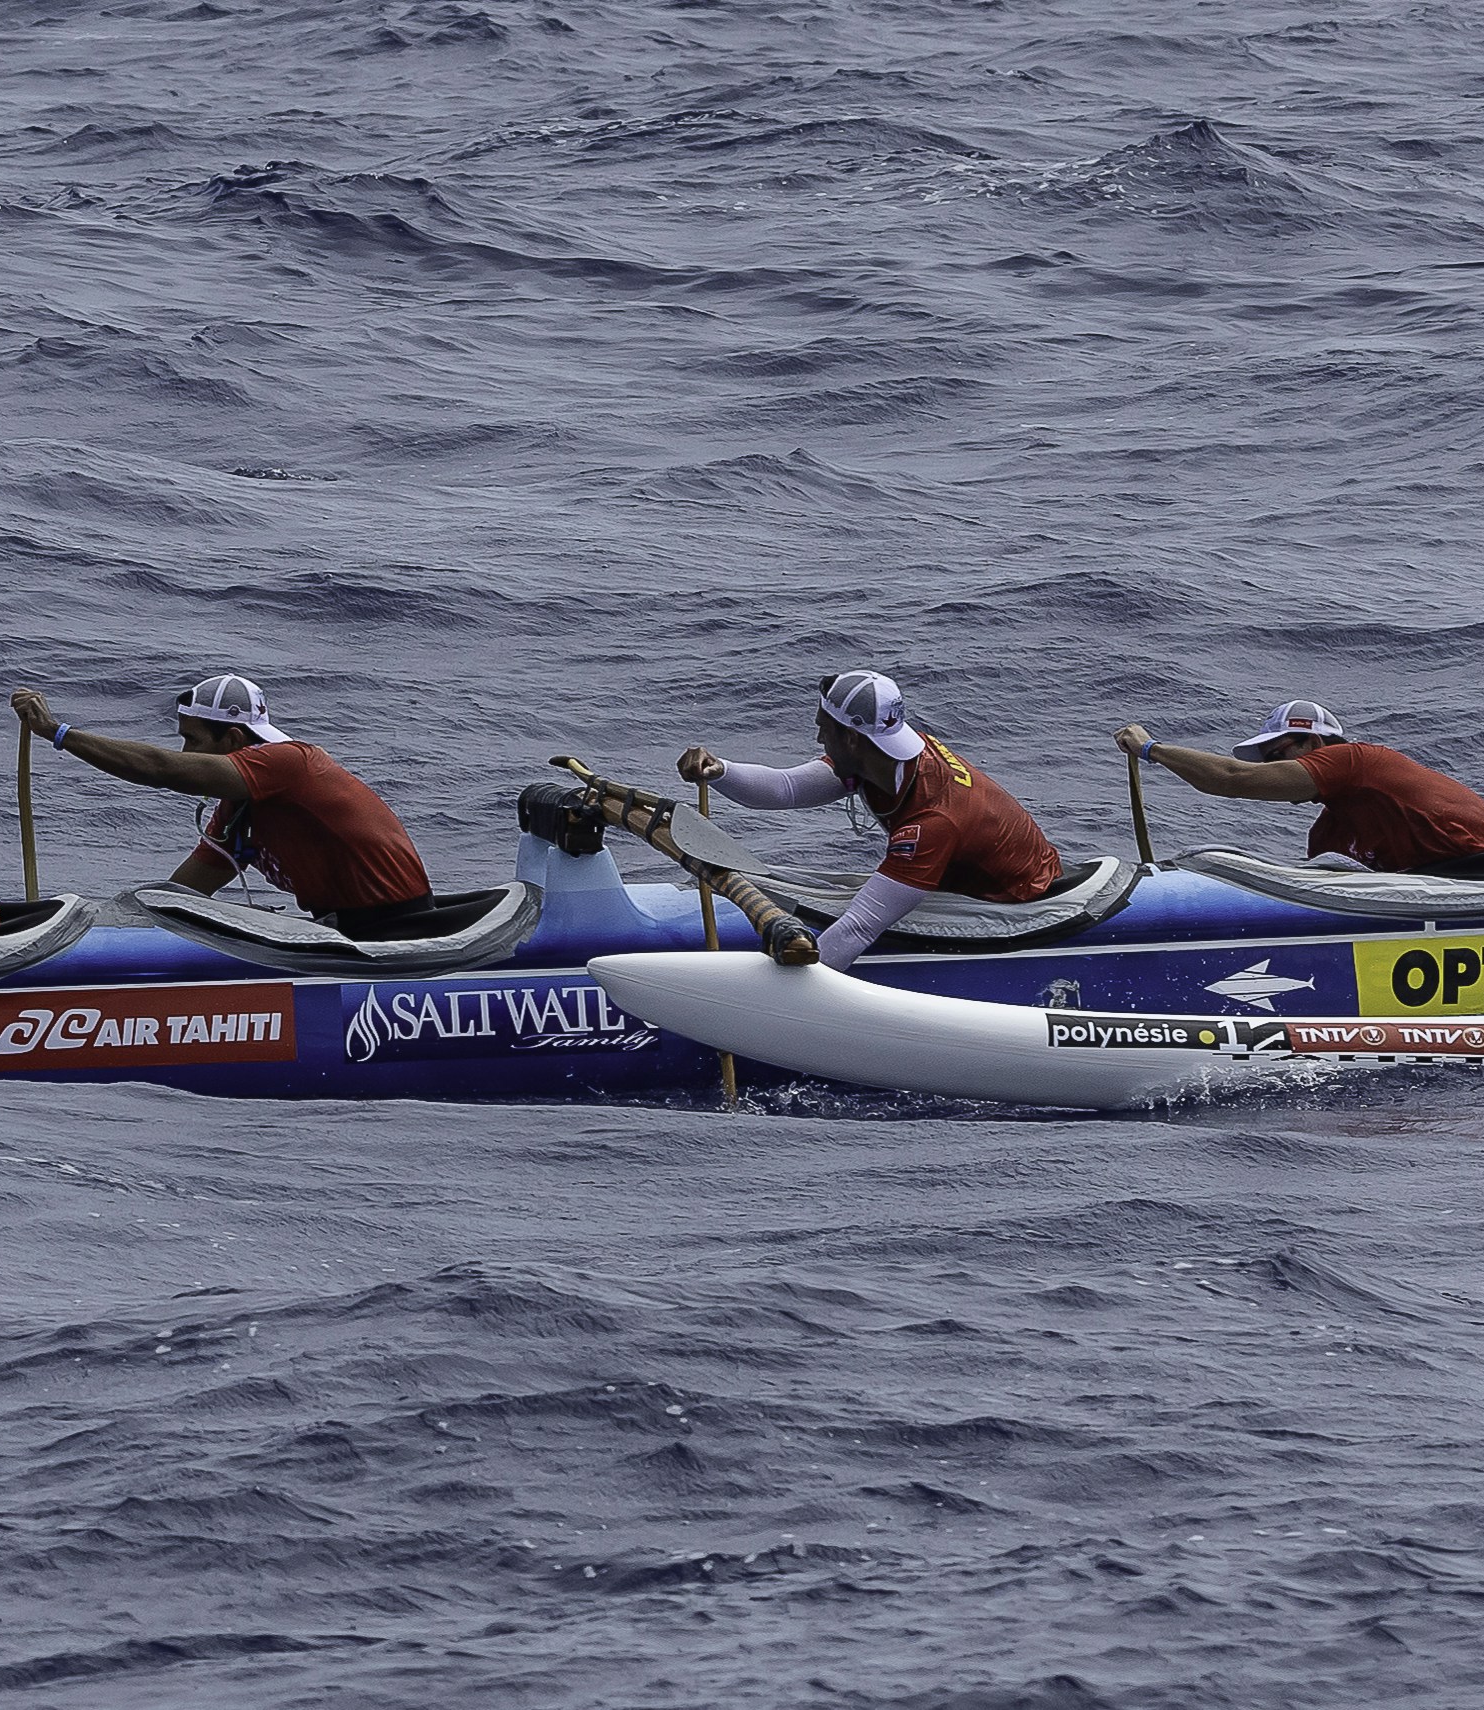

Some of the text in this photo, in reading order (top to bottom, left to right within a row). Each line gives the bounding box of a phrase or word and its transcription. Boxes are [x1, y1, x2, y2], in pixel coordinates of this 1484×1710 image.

[93, 1012, 283, 1047] AIR TAHITI
[511, 1030, 659, 1051] Family
[1052, 1021, 1189, 1049] polynésie
[1295, 1025, 1462, 1044] TNTV TNTV
